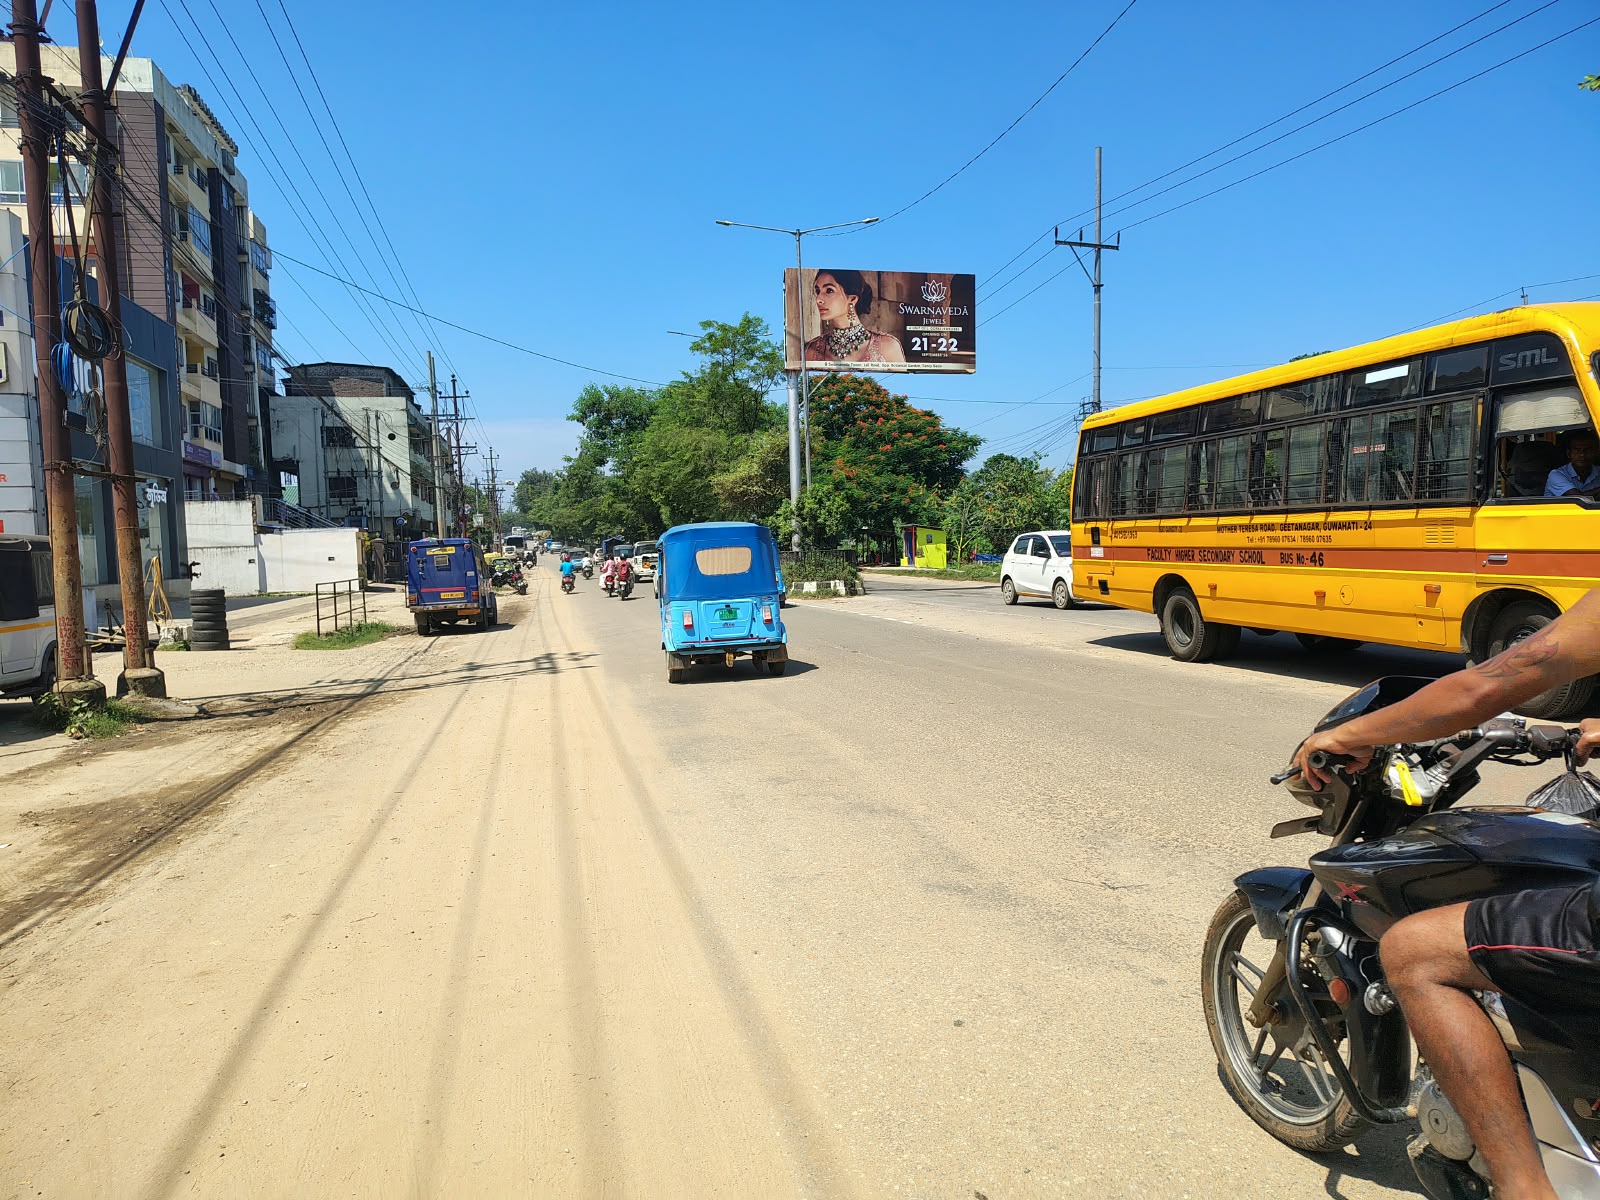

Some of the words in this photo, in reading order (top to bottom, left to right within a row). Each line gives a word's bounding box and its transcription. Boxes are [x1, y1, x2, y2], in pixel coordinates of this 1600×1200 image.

[923, 317, 947, 325] JEWELS
[1216, 525, 1238, 534] MOTHER
[1239, 525, 1259, 533] TERESA
[1279, 522, 1321, 533] GEETANAGAR,
[1322, 521, 1358, 531] GUWAHATI
[1363, 521, 1373, 531] 24
[1146, 548, 1172, 561] FACULTY
[1174, 548, 1196, 562] HIGHER
[1198, 549, 1236, 563] SECONDARY
[1239, 550, 1266, 565] SCHOOL
[1280, 552, 1294, 565] BUS
